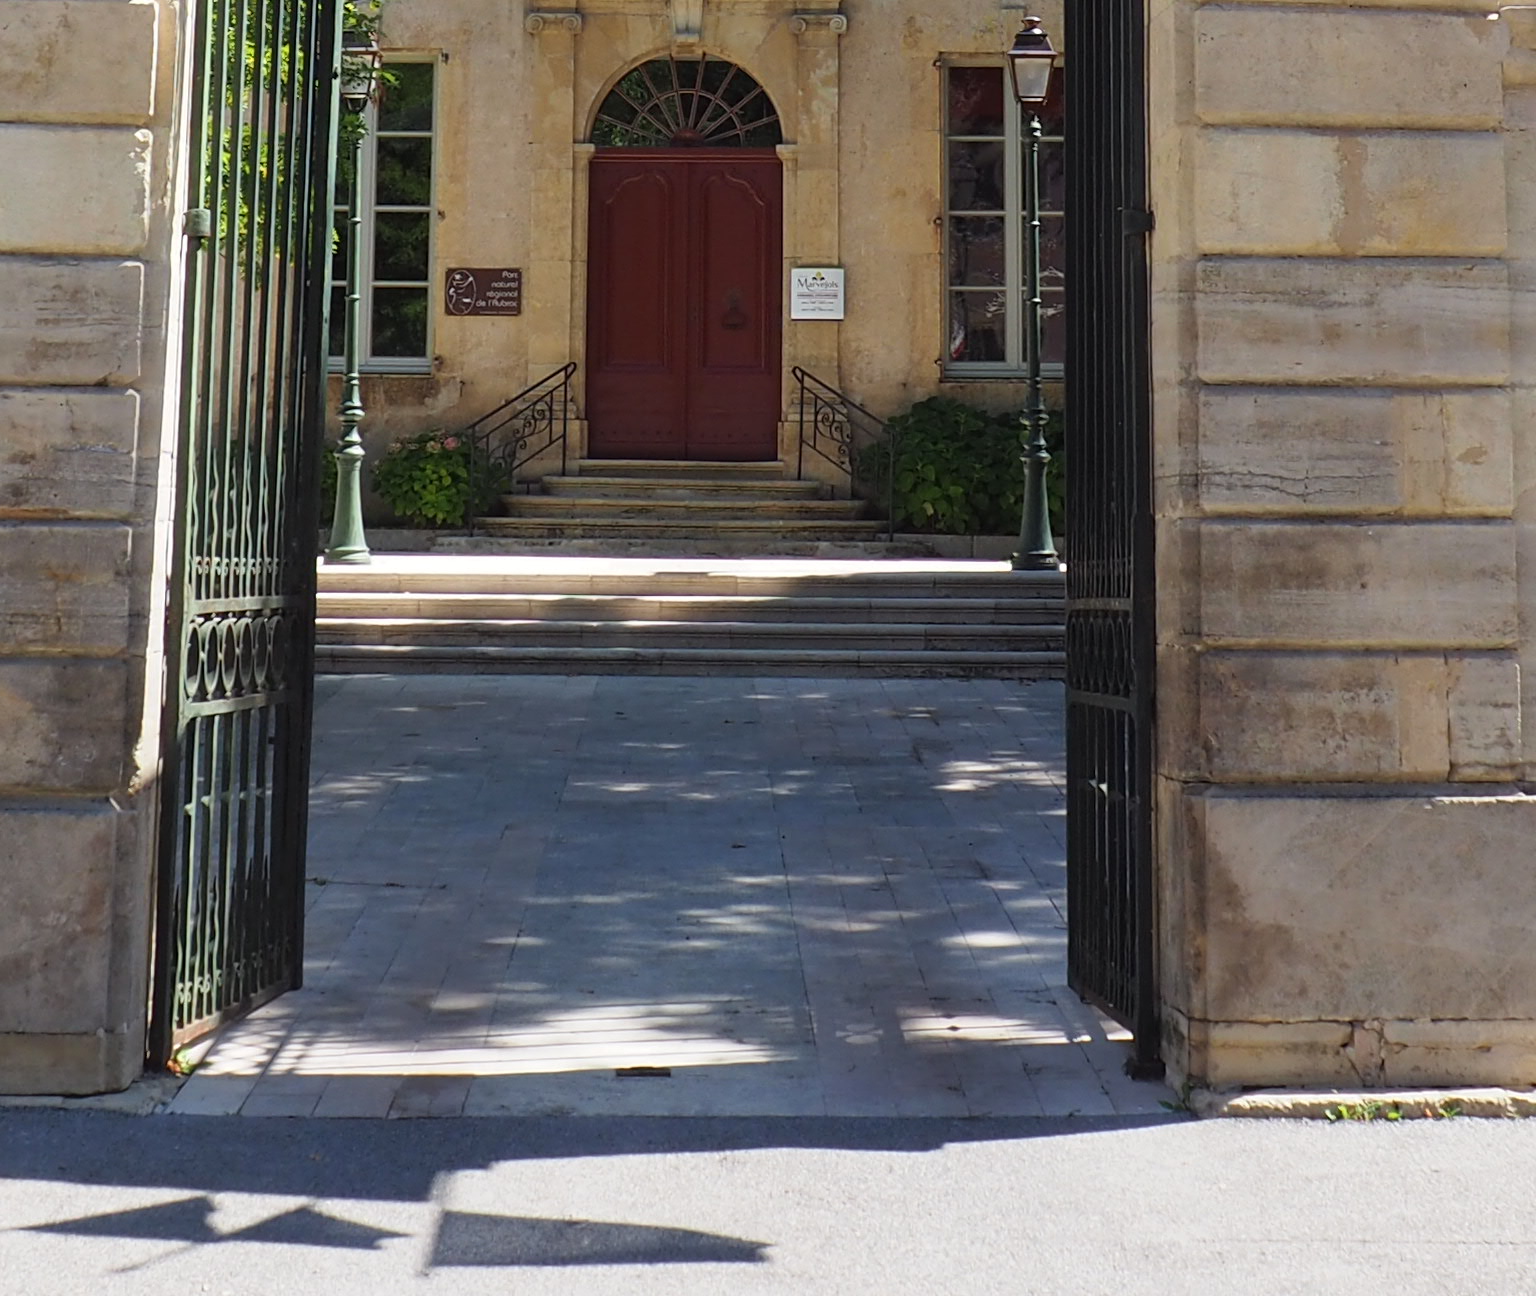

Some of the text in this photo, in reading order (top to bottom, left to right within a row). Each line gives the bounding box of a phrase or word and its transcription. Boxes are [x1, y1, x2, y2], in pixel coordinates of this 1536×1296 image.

[490, 280, 519, 288] naturel
[485, 290, 519, 299] régional
[475, 299, 486, 307] de
